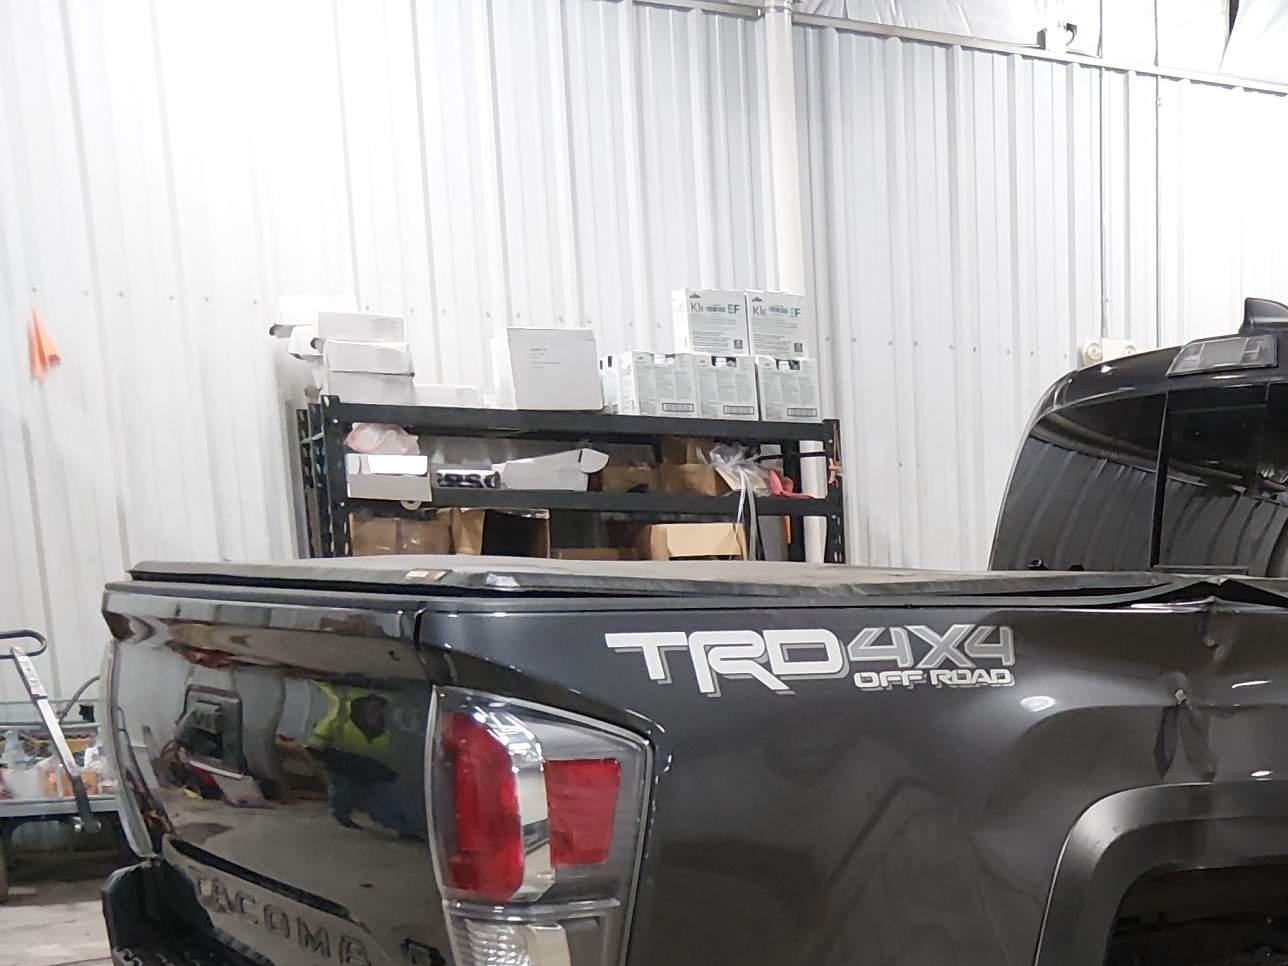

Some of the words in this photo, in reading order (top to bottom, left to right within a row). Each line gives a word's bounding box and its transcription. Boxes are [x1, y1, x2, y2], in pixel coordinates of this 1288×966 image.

[605, 629, 850, 697] TRD
[847, 624, 1016, 668] 4X4
[853, 669, 927, 691] OFF
[930, 668, 1015, 689] ROAD
